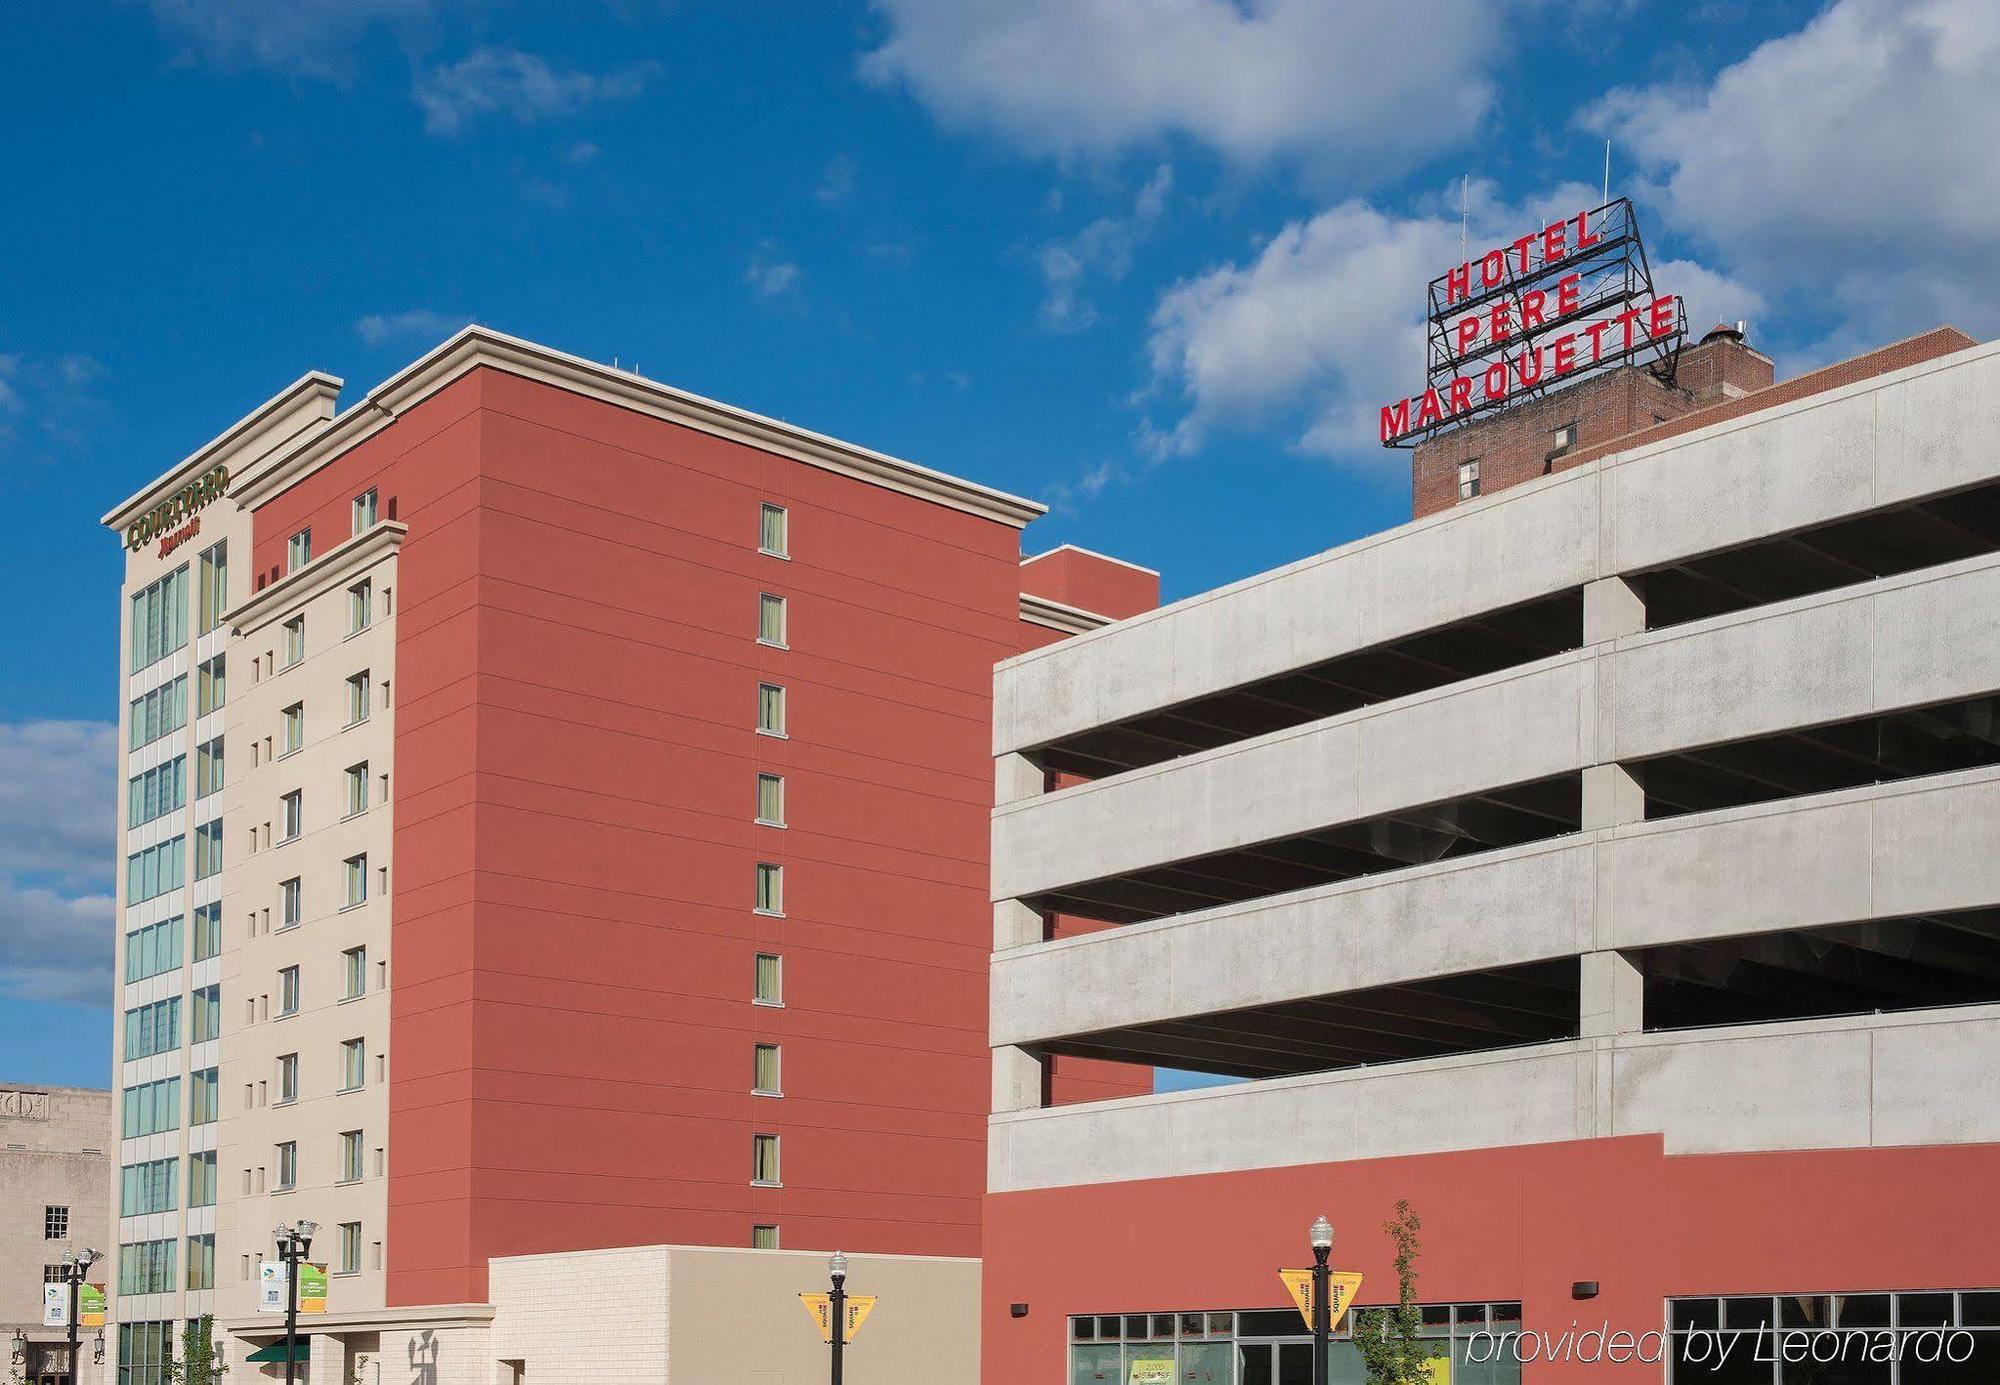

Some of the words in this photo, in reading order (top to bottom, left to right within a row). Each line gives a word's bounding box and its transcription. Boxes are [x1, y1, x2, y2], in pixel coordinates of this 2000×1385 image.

[1446, 210, 1601, 304] HOTEL
[1457, 273, 1582, 357] PERE
[1380, 294, 1676, 443] MARQUETTE
